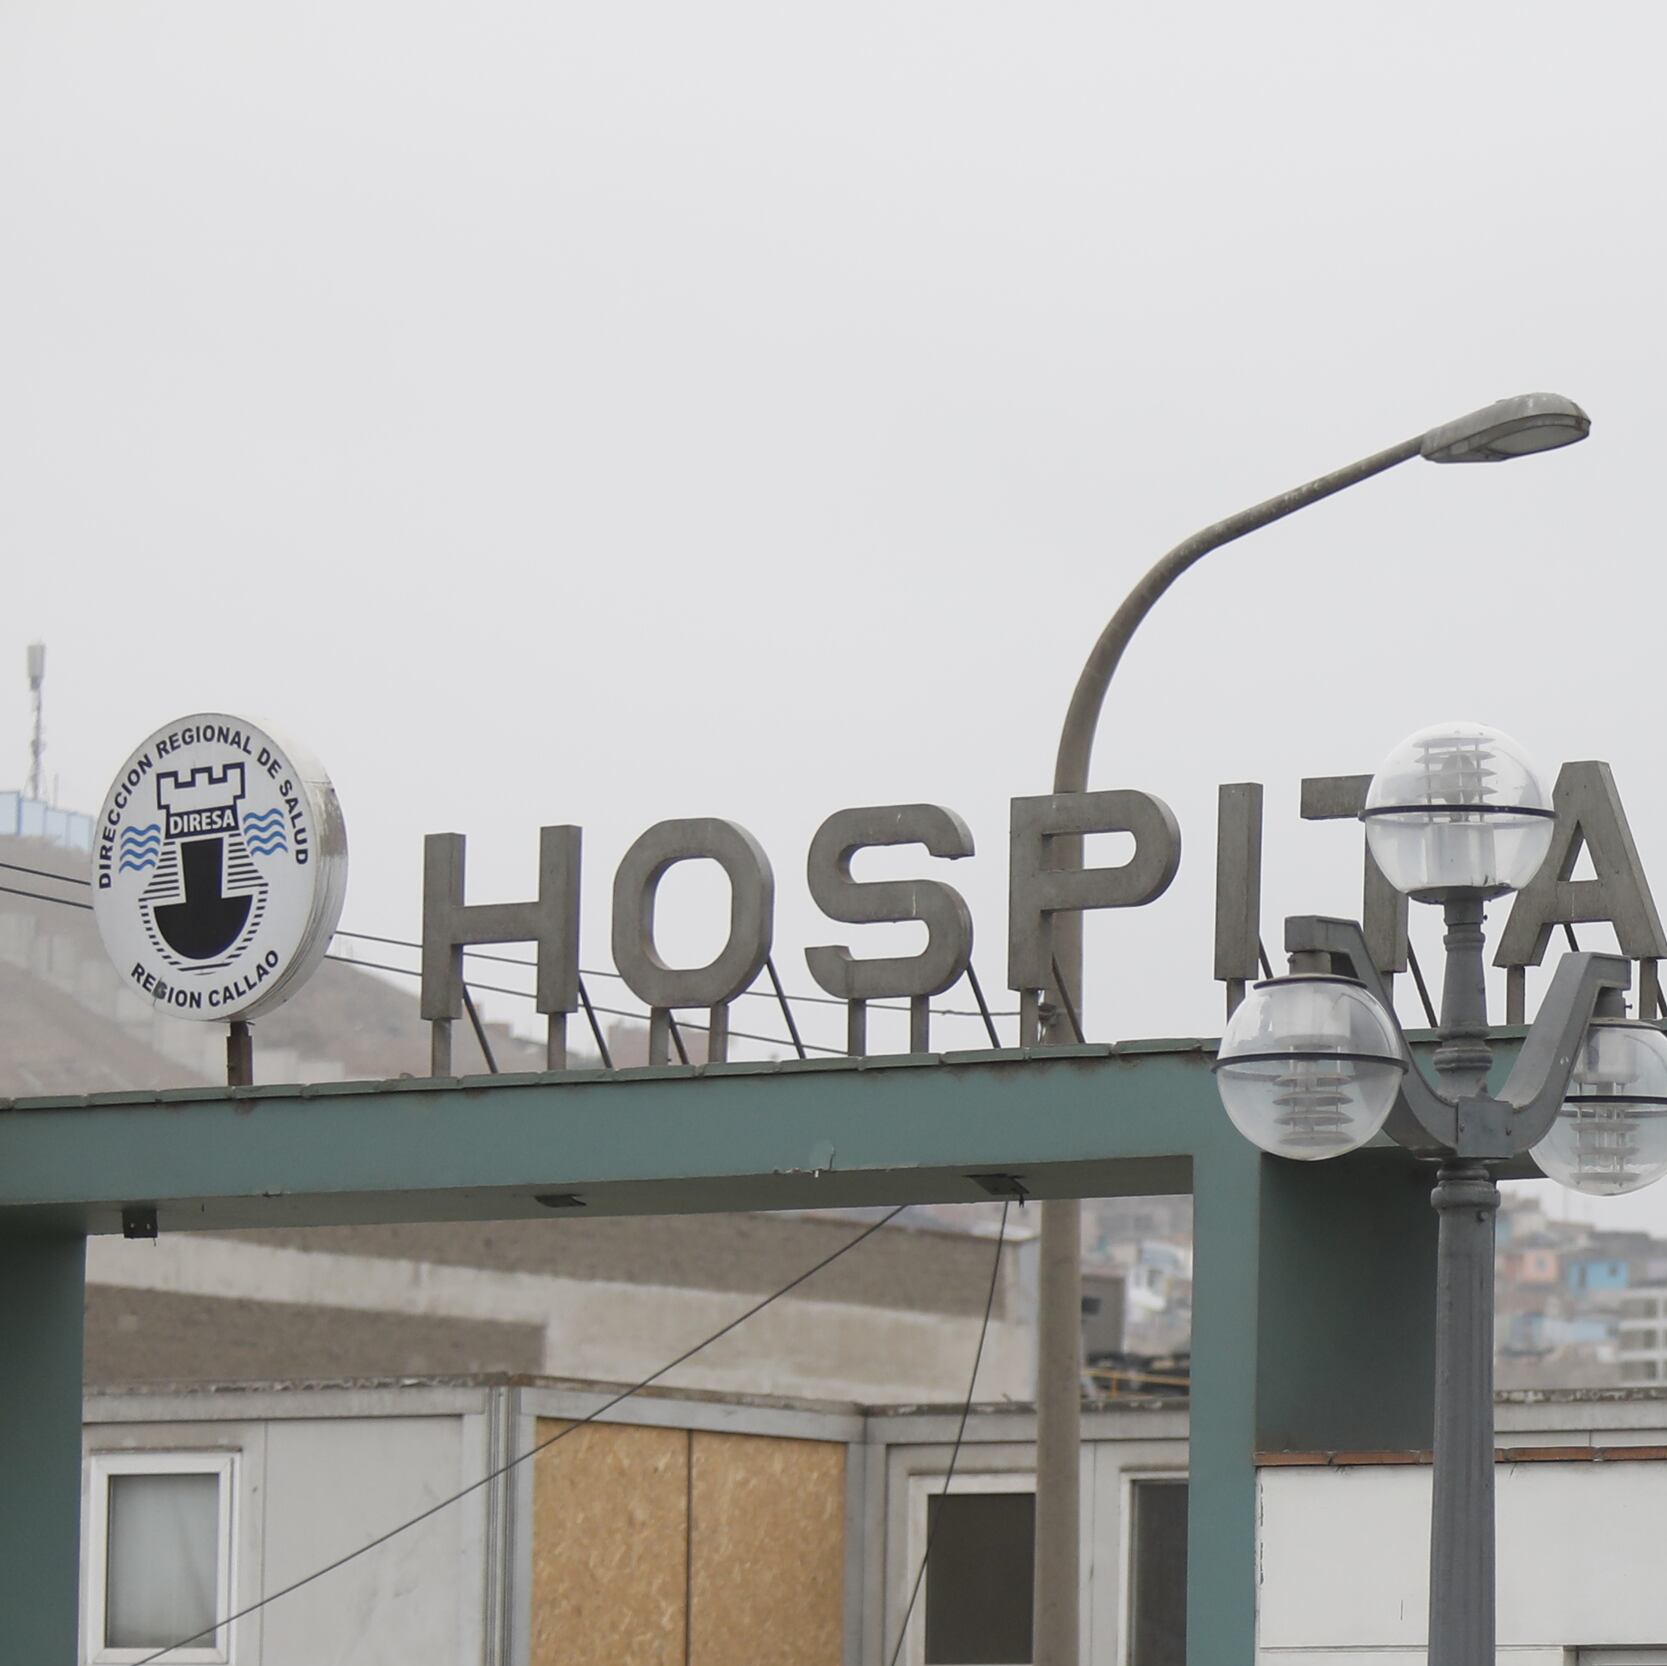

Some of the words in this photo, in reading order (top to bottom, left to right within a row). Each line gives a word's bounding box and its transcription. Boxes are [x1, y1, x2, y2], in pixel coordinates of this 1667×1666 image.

[99, 754, 153, 889] DIRECCION
[155, 724, 252, 760] REGIONAL
[257, 748, 282, 779] DE
[279, 779, 309, 865] SALUD
[169, 809, 235, 836] DIRESA
[131, 962, 201, 1009] REGION
[208, 949, 279, 1007] CALLAO
